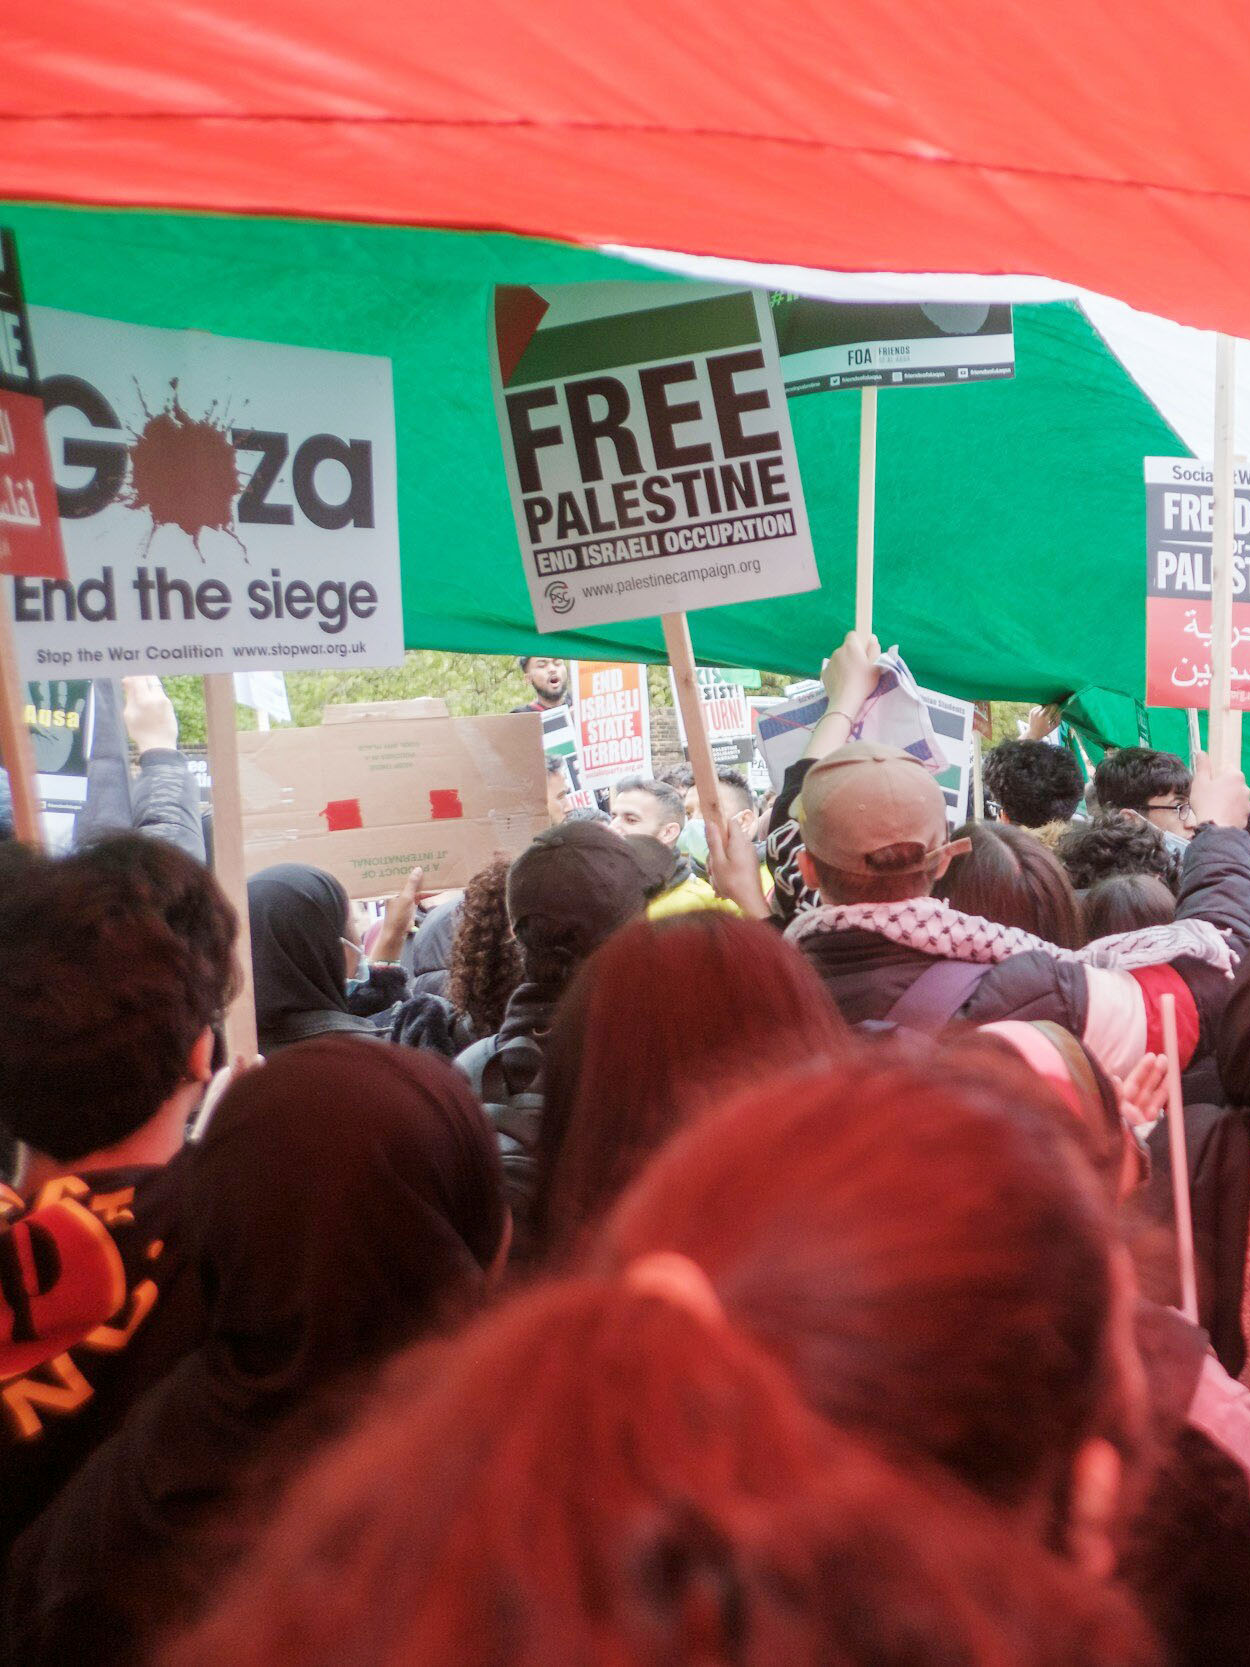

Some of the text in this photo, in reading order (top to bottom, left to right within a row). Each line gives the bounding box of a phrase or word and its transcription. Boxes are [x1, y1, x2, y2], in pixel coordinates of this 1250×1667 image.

[847, 347, 872, 366] FOA
[878, 345, 911, 356] FRIENDS
[504, 348, 783, 494] FREE
[40, 373, 376, 531] Gza
[522, 455, 792, 544] PALESTINE
[535, 512, 795, 574] END ISRAELI OCCUPATION
[581, 556, 762, 599] www.palestinecampaign.org
[14, 565, 379, 634] End the siege
[36, 640, 368, 666] Stop the War Coalition www.stopwar.org.uk
[591, 668, 623, 695] END
[581, 688, 640, 721] ISRAELI
[587, 713, 635, 745] STATE
[583, 735, 644, 770] TERROR
